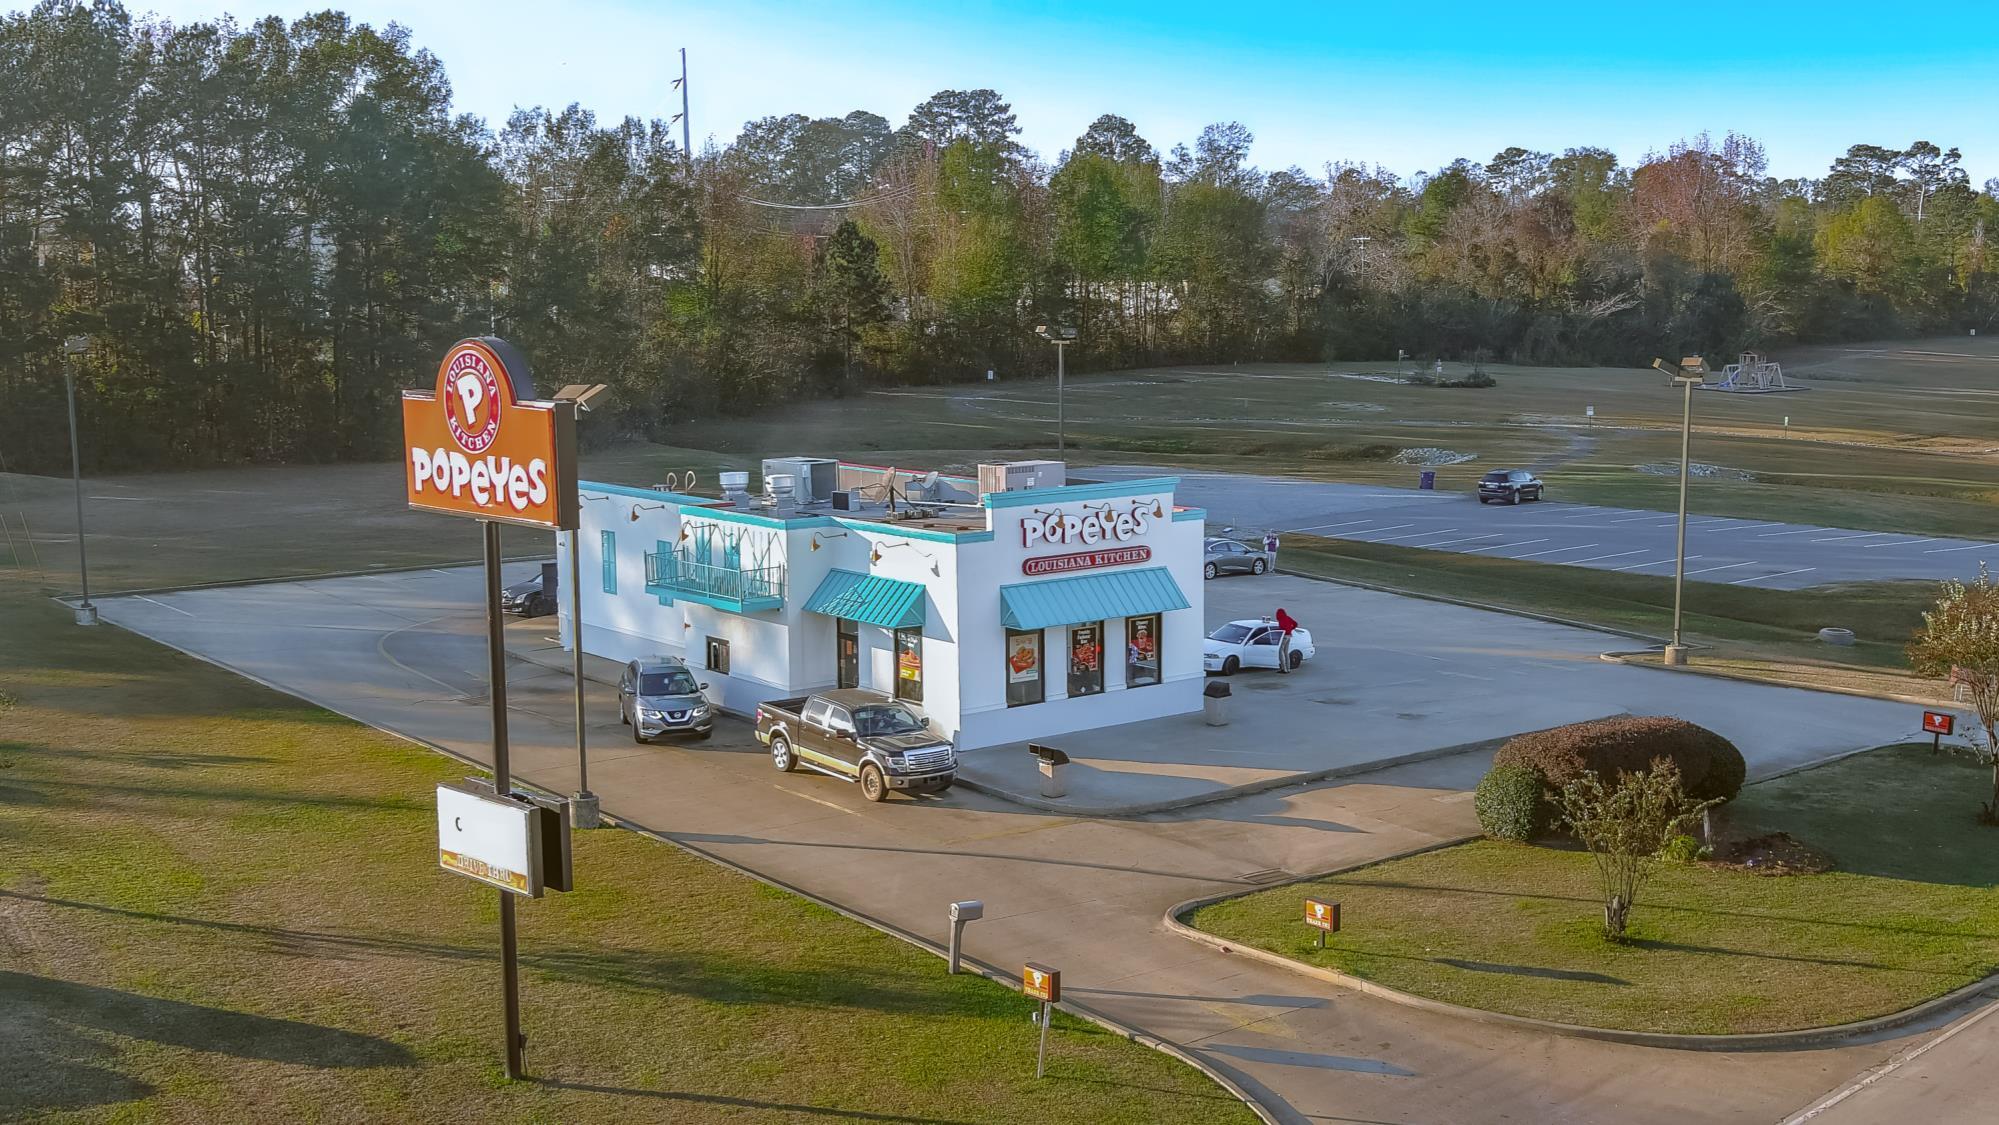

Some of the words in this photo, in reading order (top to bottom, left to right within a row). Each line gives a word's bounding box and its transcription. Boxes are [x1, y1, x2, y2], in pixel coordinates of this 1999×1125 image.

[446, 354, 495, 398] LOUISIANA
[457, 374, 483, 425] P
[450, 416, 497, 450] KITCHEN
[1031, 556, 1092, 573] LOUISIANA
[1095, 549, 1148, 565] KITCHEN
